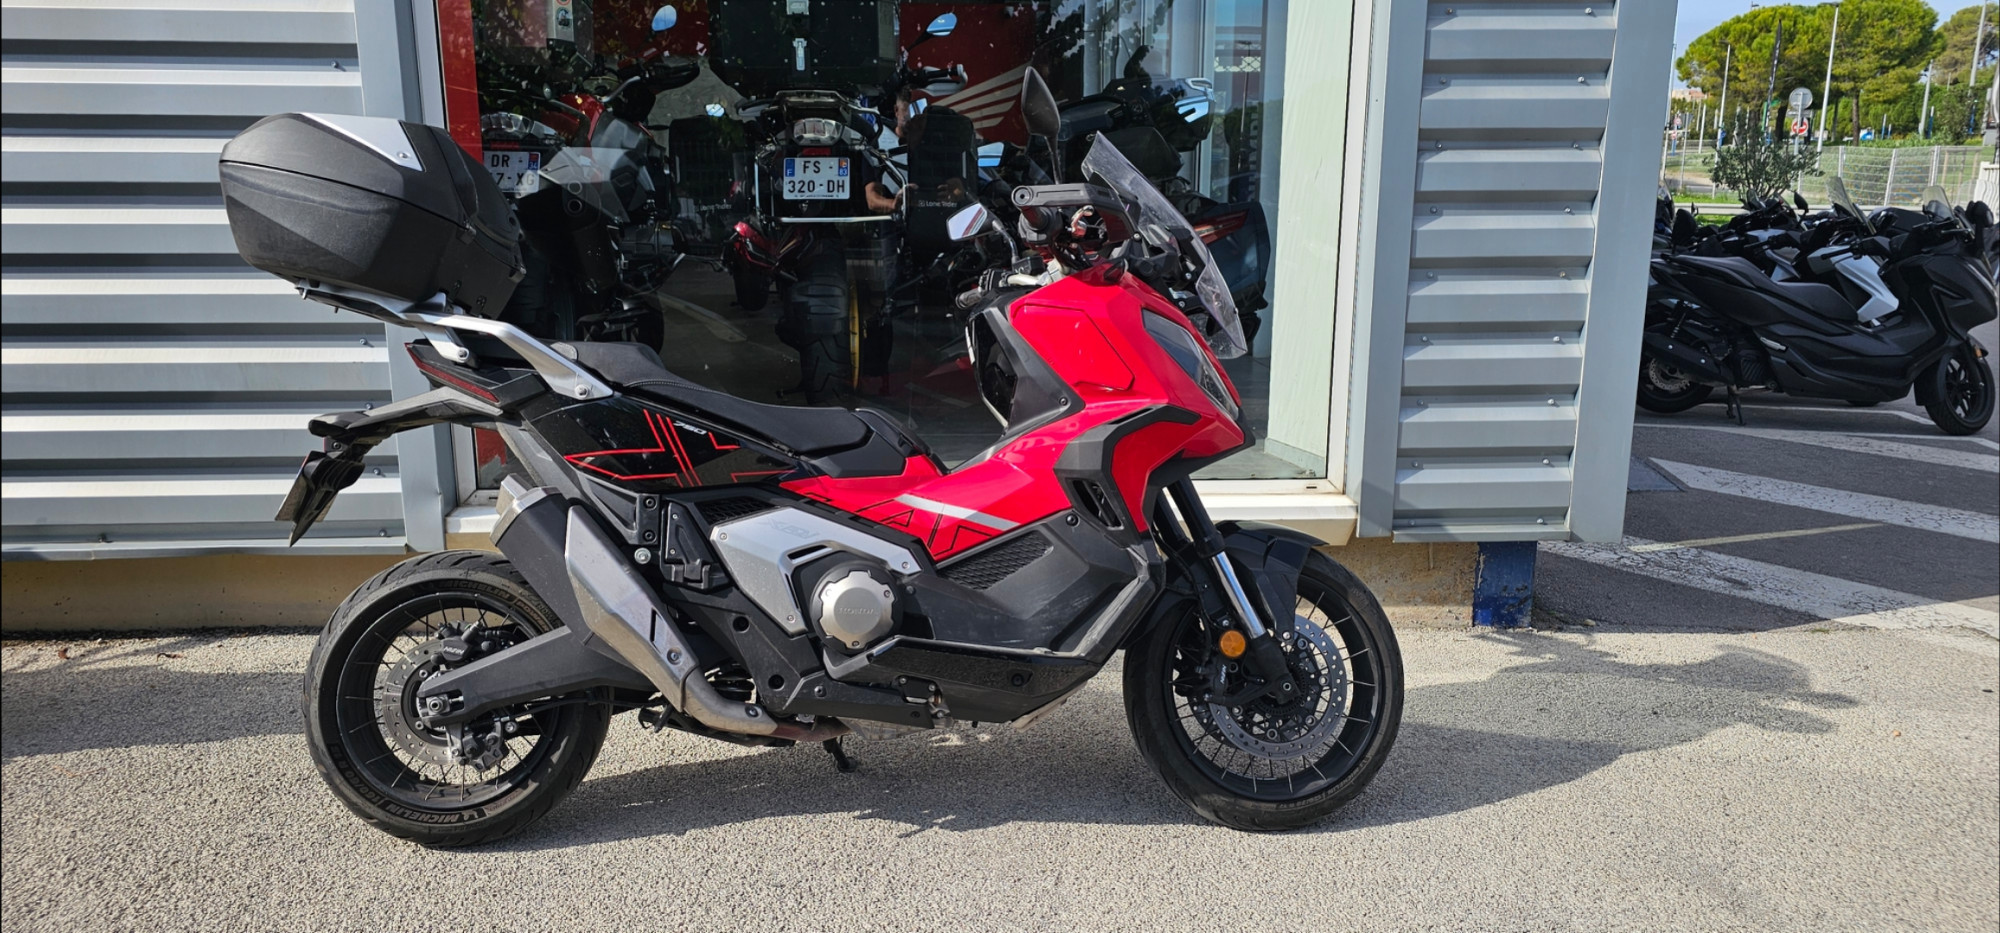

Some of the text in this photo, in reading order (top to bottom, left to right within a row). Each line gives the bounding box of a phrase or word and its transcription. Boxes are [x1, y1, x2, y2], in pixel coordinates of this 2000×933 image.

[491, 154, 510, 168] DR
[803, 160, 821, 174] FS
[788, 180, 845, 193] 320-DH
[673, 420, 707, 435] 750
[384, 802, 460, 823] MICHELIN
